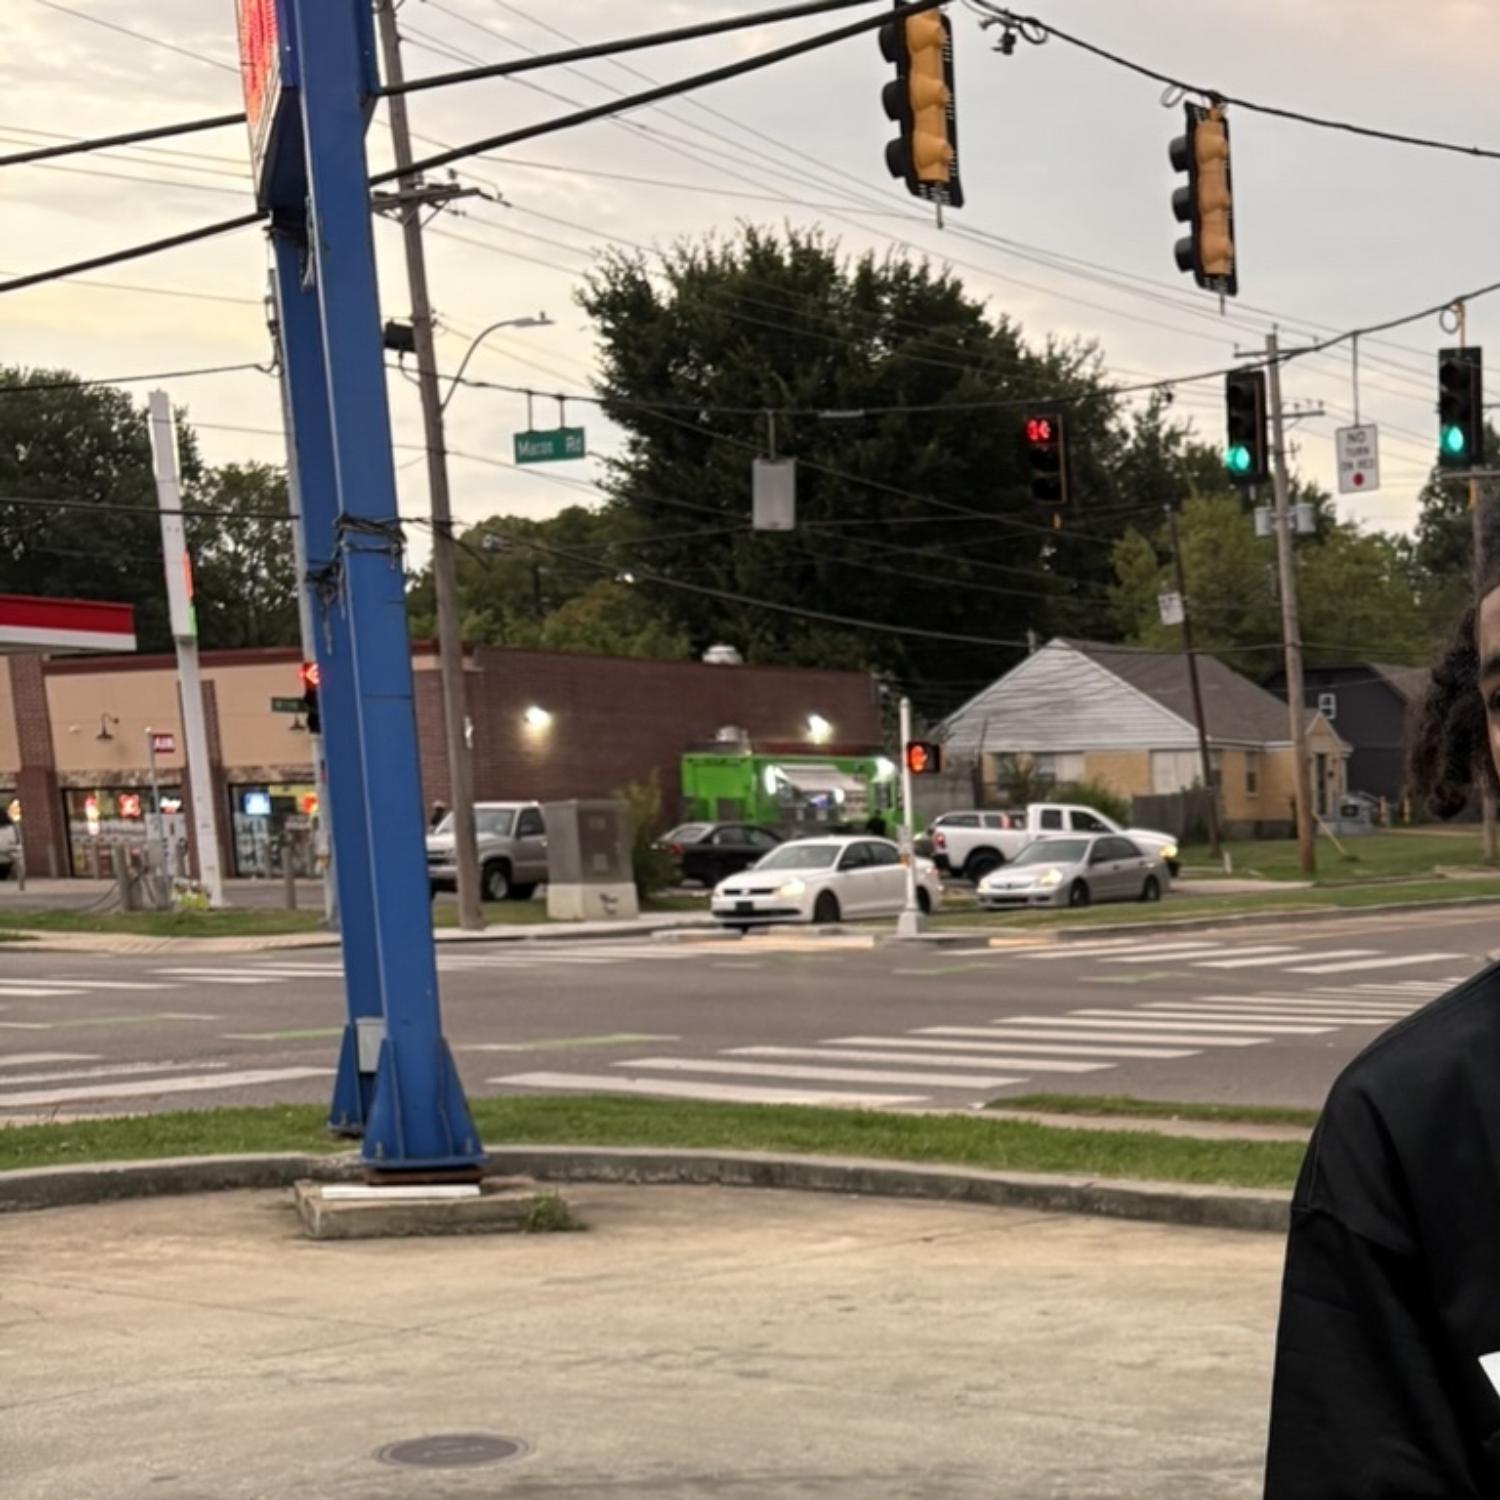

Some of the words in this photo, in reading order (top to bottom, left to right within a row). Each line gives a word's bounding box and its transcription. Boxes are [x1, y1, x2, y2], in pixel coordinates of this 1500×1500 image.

[1346, 431, 1366, 443] NO
[566, 435, 582, 453] Rd
[1345, 446, 1370, 458] TURN
[1341, 461, 1355, 471] ON
[1357, 459, 1375, 470] RED
